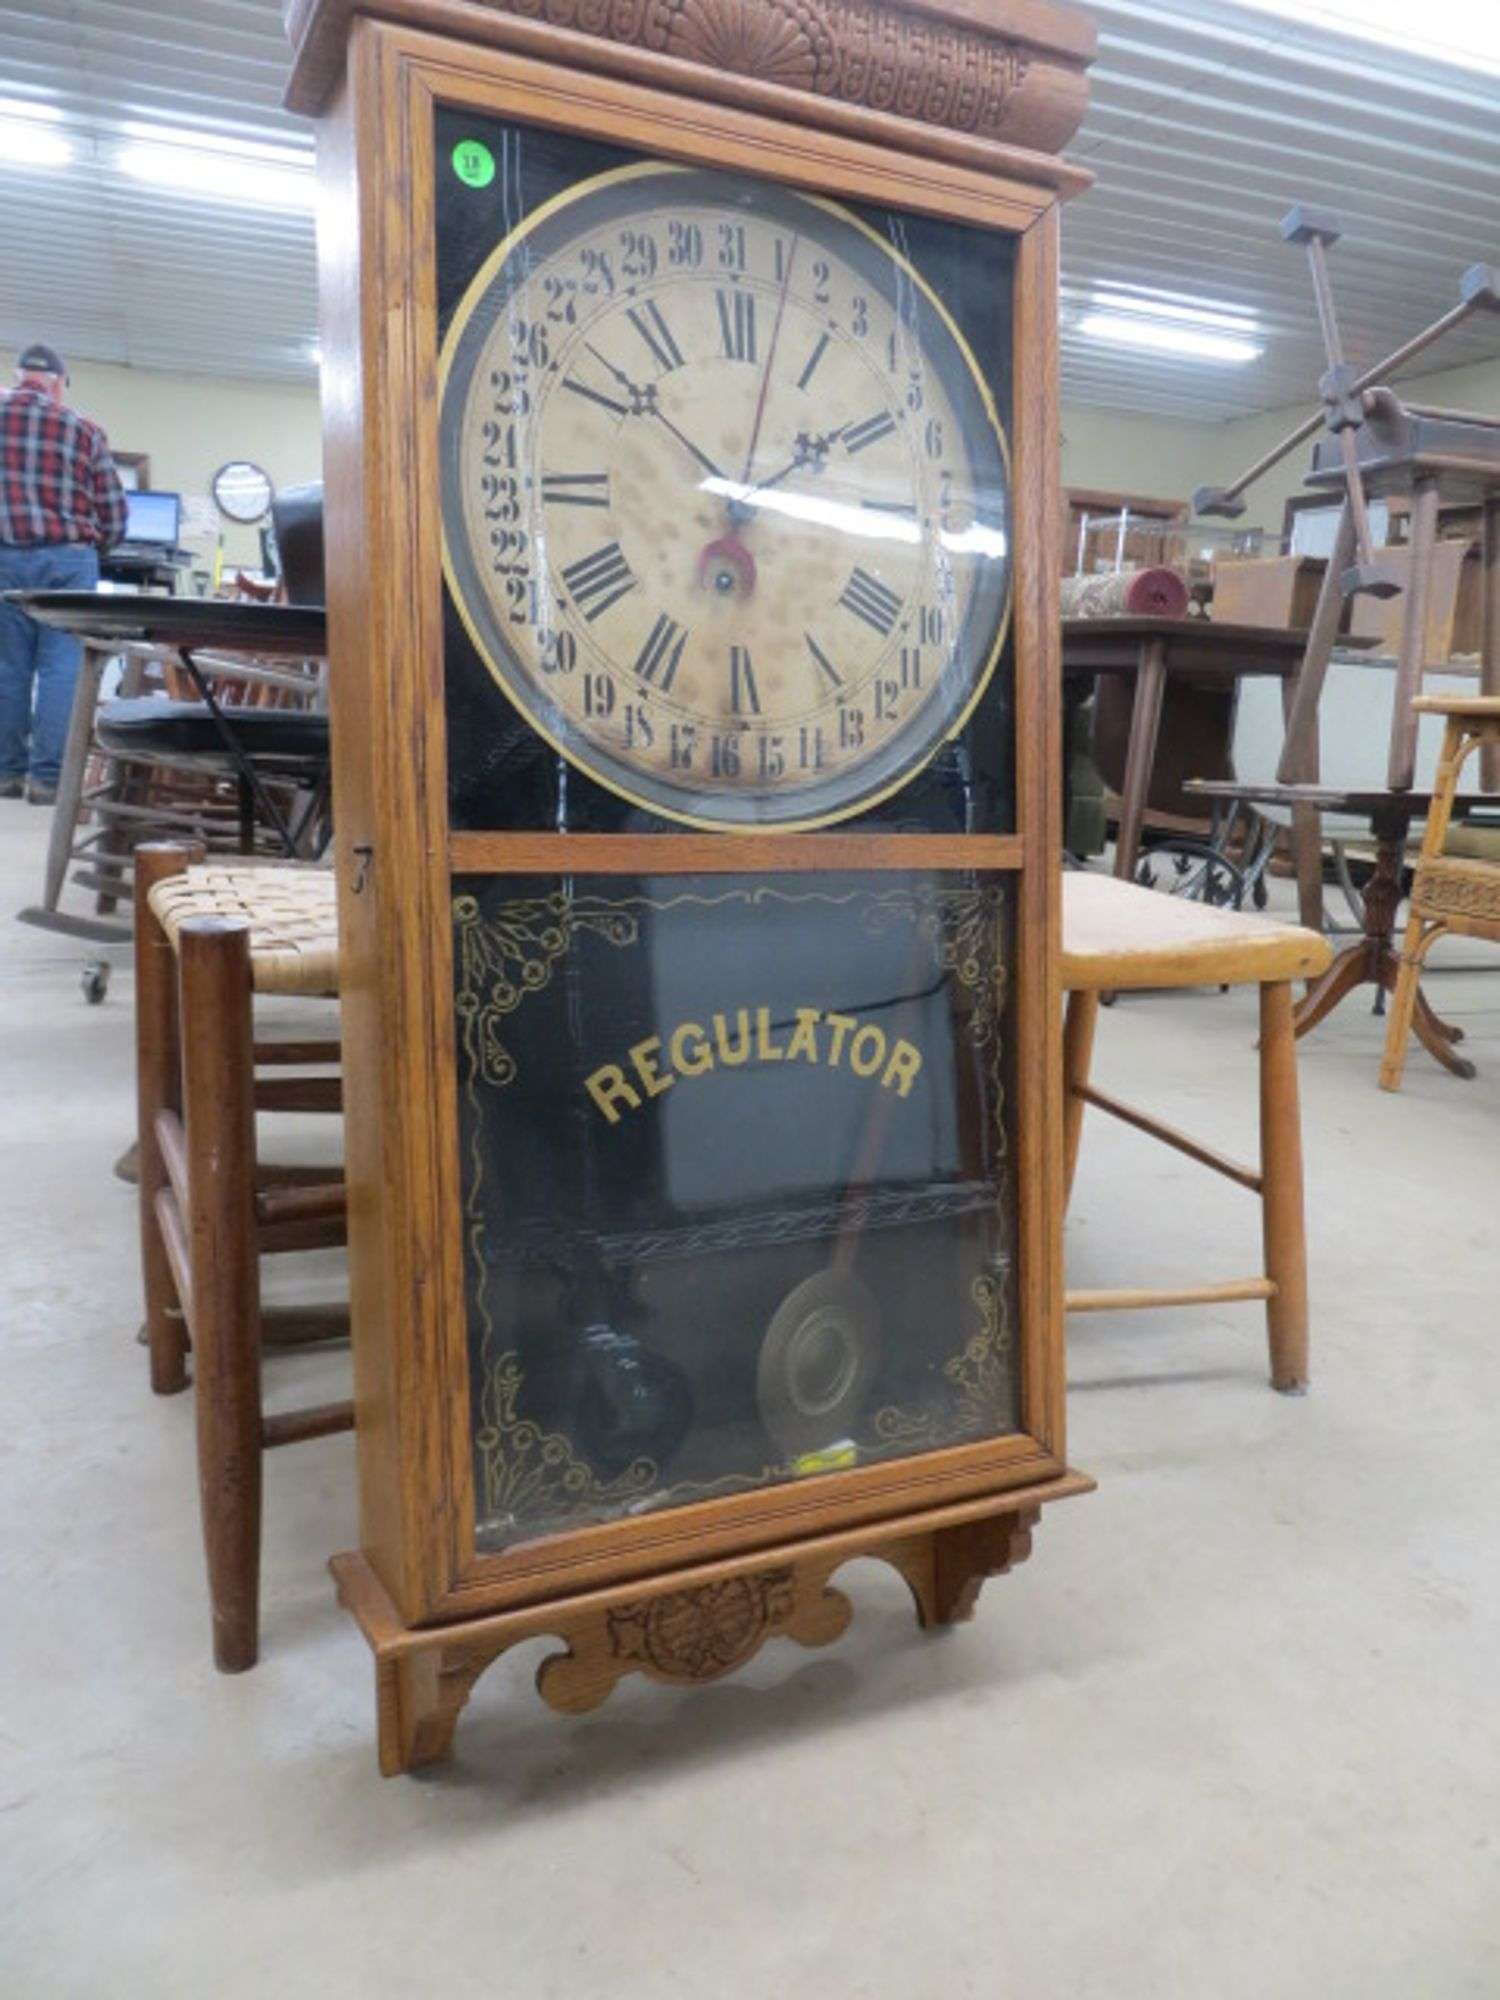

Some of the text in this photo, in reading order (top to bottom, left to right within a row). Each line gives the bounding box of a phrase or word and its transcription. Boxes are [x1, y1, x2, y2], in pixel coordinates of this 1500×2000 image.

[620, 230, 657, 276] 29
[668, 220, 701, 267] 30
[718, 223, 745, 271] 31
[813, 261, 830, 304] 2
[852, 296, 868, 338] 3
[923, 417, 943, 460] 6
[490, 529, 529, 575] 22
[920, 605, 943, 645] 10
[902, 646, 922, 689] 11
[583, 672, 616, 718] 19
[875, 679, 899, 720] 12
[839, 709, 865, 748] 13
[712, 732, 741, 778] 16
[759, 734, 786, 778] 15
[584, 1008, 923, 1124] REGULATOR
